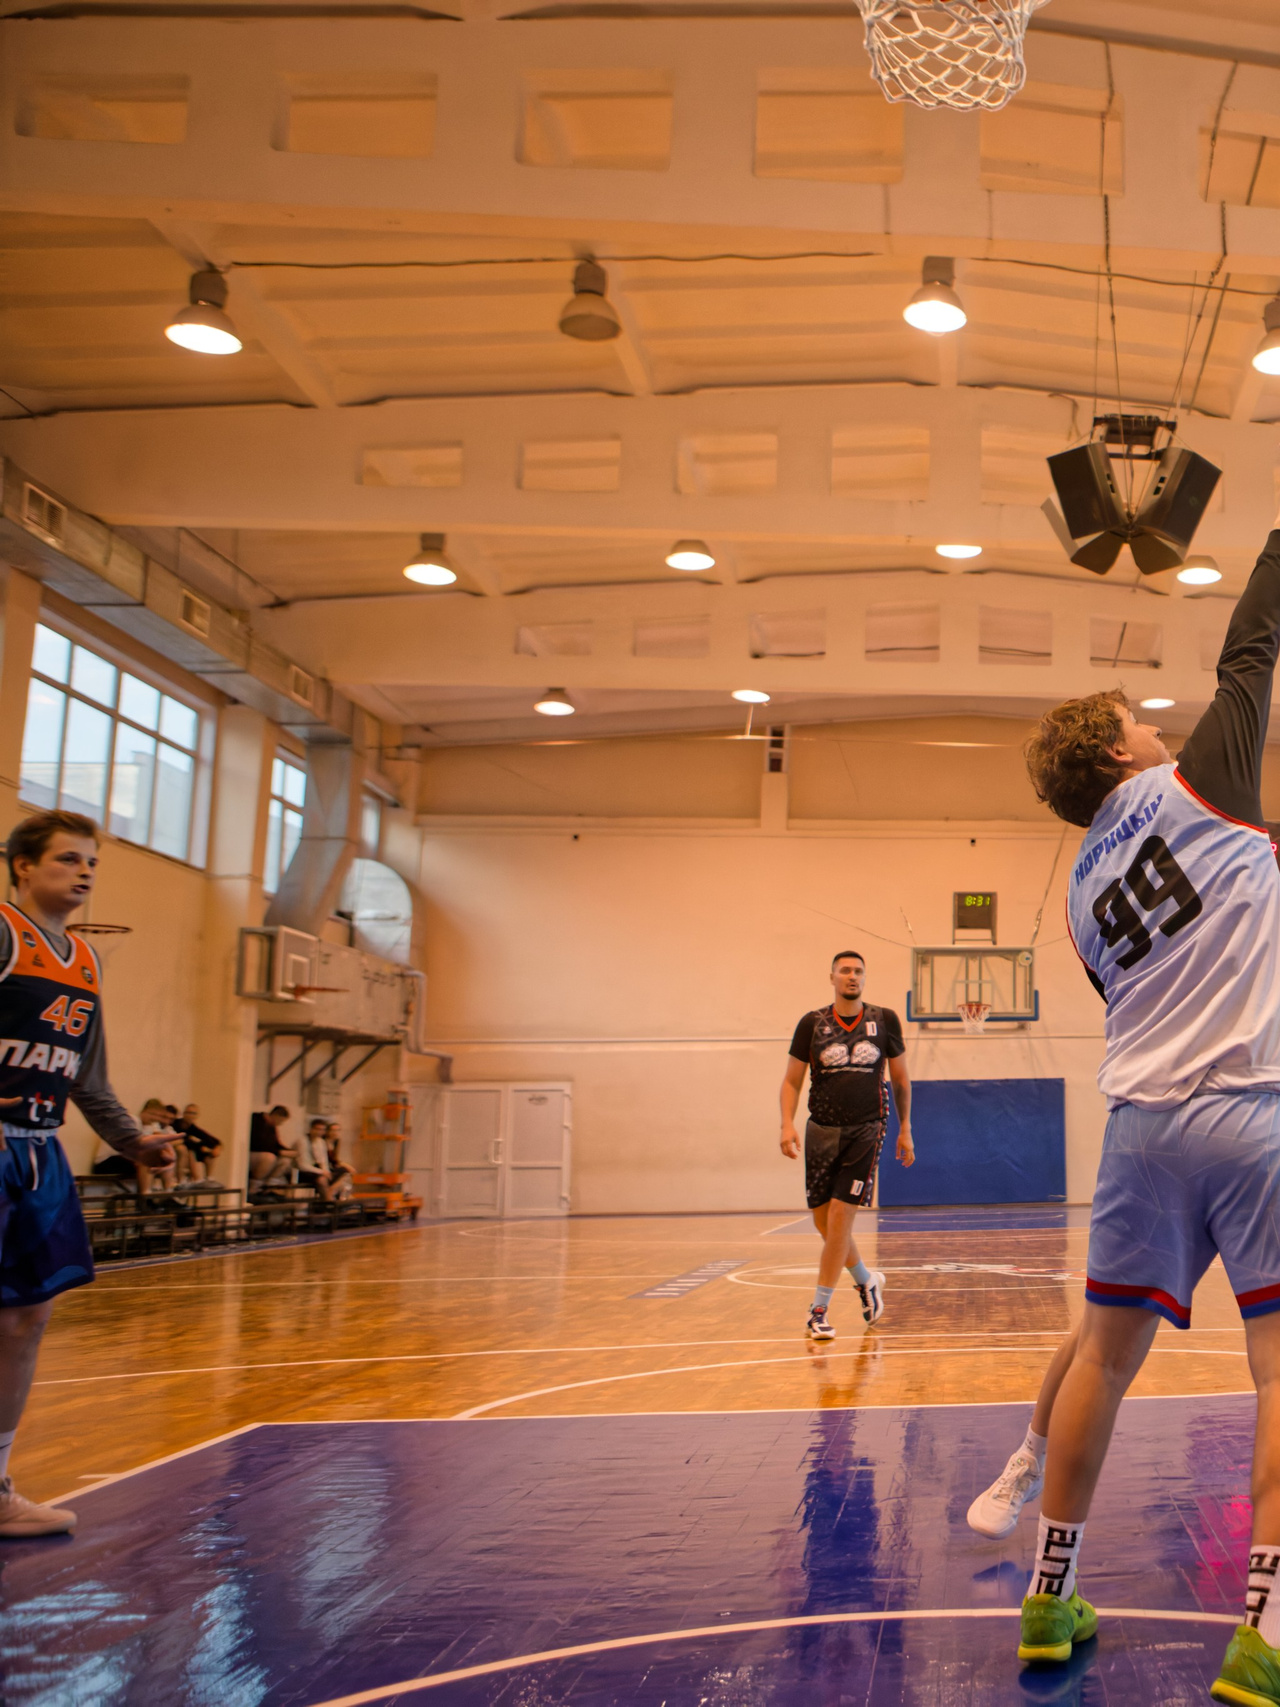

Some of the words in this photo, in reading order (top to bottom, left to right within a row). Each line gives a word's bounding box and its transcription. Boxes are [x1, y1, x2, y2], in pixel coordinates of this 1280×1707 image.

[1092, 835, 1203, 971] 99
[39, 994, 95, 1037] 46
[865, 1021, 878, 1037] 10
[849, 1179, 865, 1197] 10
